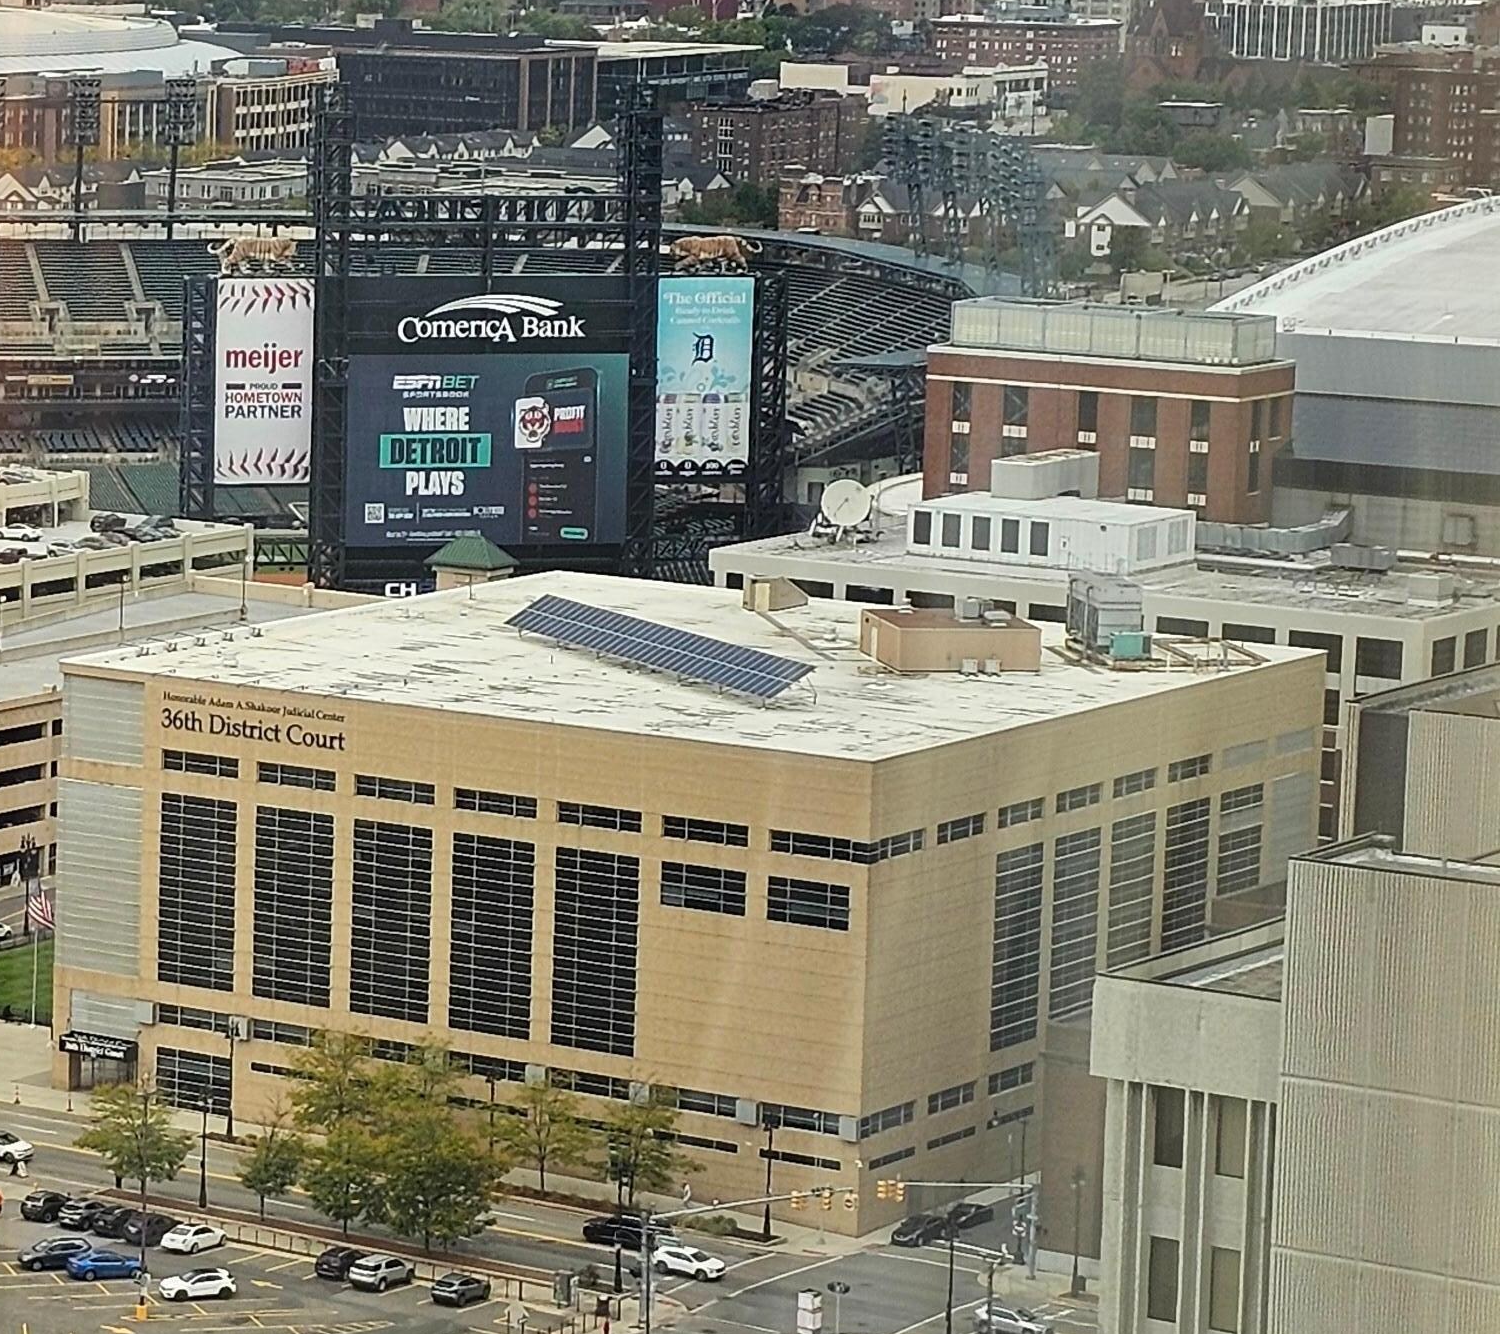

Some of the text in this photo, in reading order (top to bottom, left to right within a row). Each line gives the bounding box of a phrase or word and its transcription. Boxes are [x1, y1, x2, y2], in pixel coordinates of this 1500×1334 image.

[521, 316, 586, 338] Bank
[226, 343, 303, 374] meijer
[442, 375, 480, 389] BET
[225, 392, 302, 404] HOMETOWN
[225, 405, 302, 419] PARTNER
[403, 407, 469, 431] WHERE
[390, 437, 481, 464] DETROIT
[405, 471, 464, 495] PLAYS
[163, 691, 207, 706] Honorable
[208, 697, 234, 709] Adam
[282, 706, 315, 719] Judicial
[315, 710, 345, 723] Center
[161, 707, 346, 751] 36th District Court
